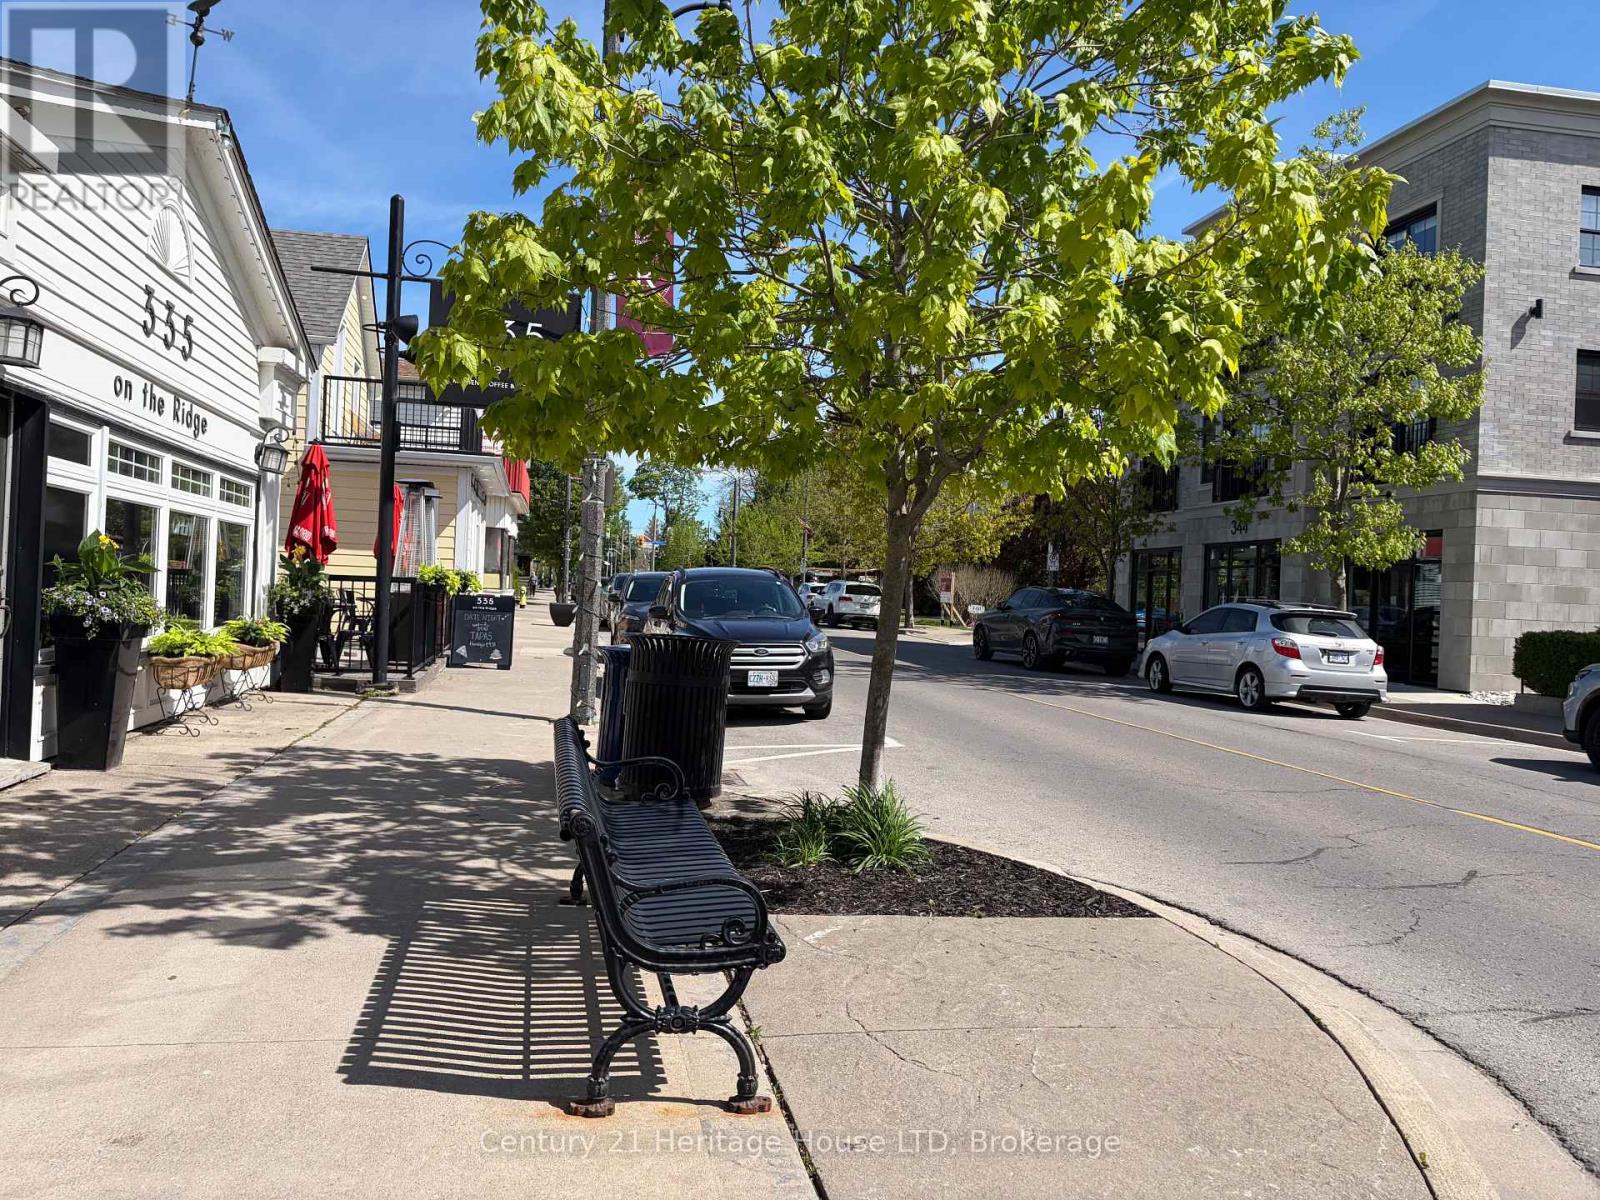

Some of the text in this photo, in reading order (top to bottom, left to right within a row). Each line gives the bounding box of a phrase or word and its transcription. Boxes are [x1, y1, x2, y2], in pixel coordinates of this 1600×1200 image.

[142, 284, 194, 361] 335
[504, 319, 544, 339] 35
[488, 381, 509, 389] OFFEE
[113, 375, 208, 440] on the Ridge
